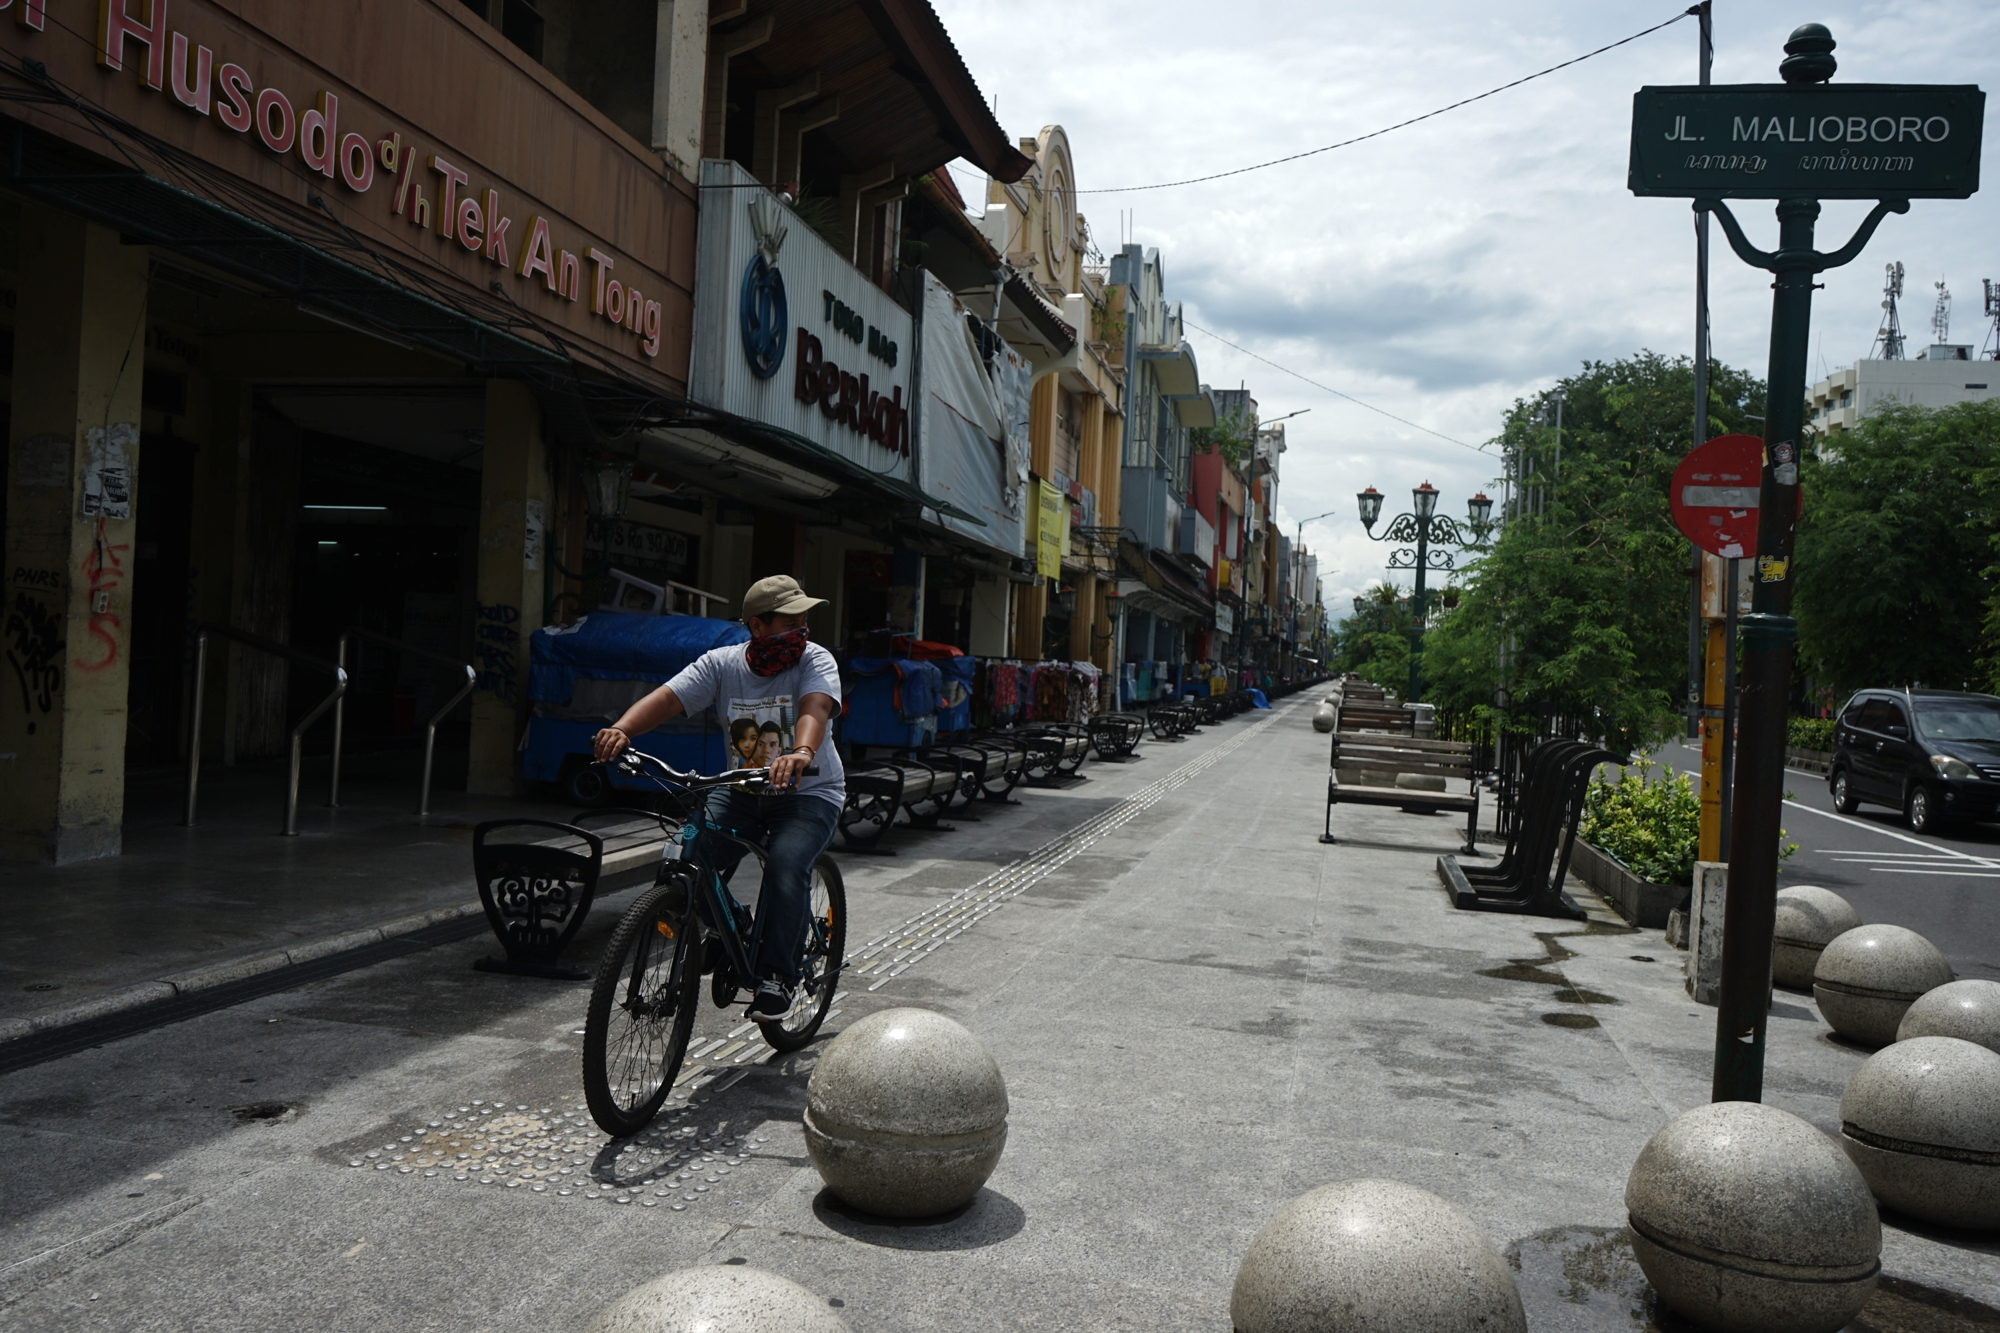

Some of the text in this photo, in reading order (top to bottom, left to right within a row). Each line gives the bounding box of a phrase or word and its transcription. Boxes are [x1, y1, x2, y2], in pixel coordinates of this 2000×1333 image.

[1664, 115, 1951, 143] JL. MALIOBORO
[99, 0, 374, 192] Husodo
[428, 155, 512, 268] Tek
[516, 215, 580, 302] An
[586, 247, 662, 357] Tong
[823, 289, 898, 368] TOKO MAS
